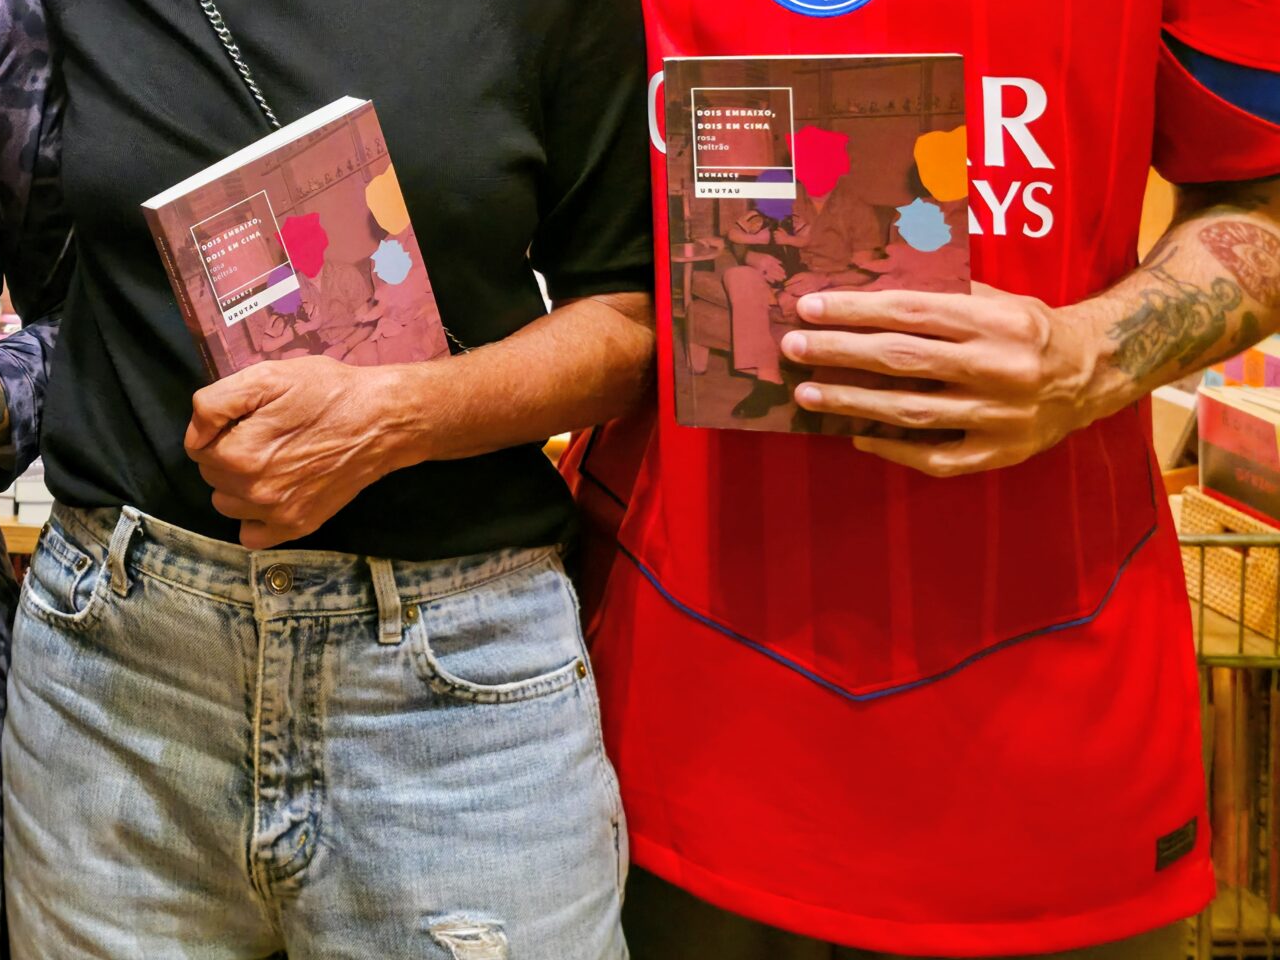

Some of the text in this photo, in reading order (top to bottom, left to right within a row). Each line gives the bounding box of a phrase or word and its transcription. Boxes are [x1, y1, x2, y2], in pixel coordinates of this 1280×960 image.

[696, 109, 776, 118] DOIS EMBAIXO,
[698, 143, 730, 151] beltrão
[201, 217, 262, 252] DOIS EMBAIXO,
[206, 231, 262, 263] DOIS EM CIMA
[228, 301, 259, 321] URUTAU
